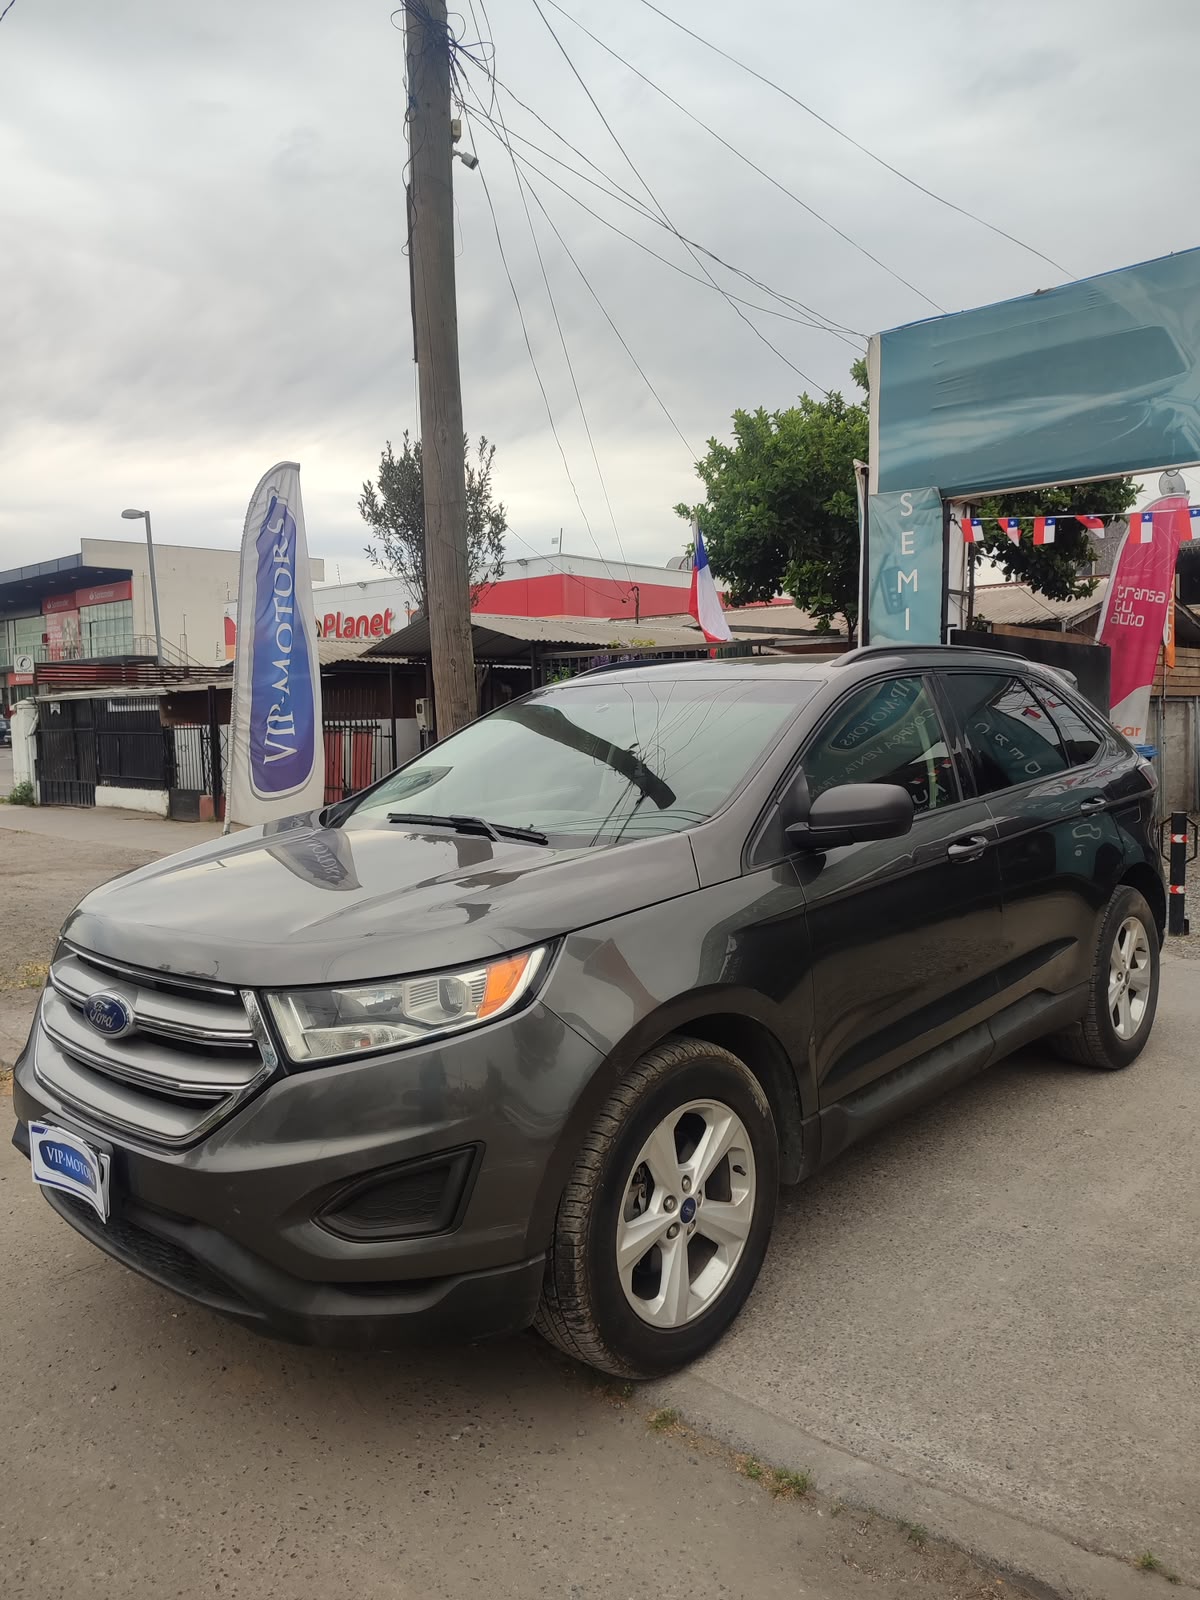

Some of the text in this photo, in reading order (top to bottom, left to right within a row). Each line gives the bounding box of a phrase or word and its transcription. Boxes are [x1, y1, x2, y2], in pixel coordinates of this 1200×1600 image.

[897, 492, 919, 631] SEMI
[1117, 584, 1166, 604] transa
[1114, 598, 1133, 613] tu
[1110, 612, 1145, 627] auto
[90, 1000, 117, 1028] Ford
